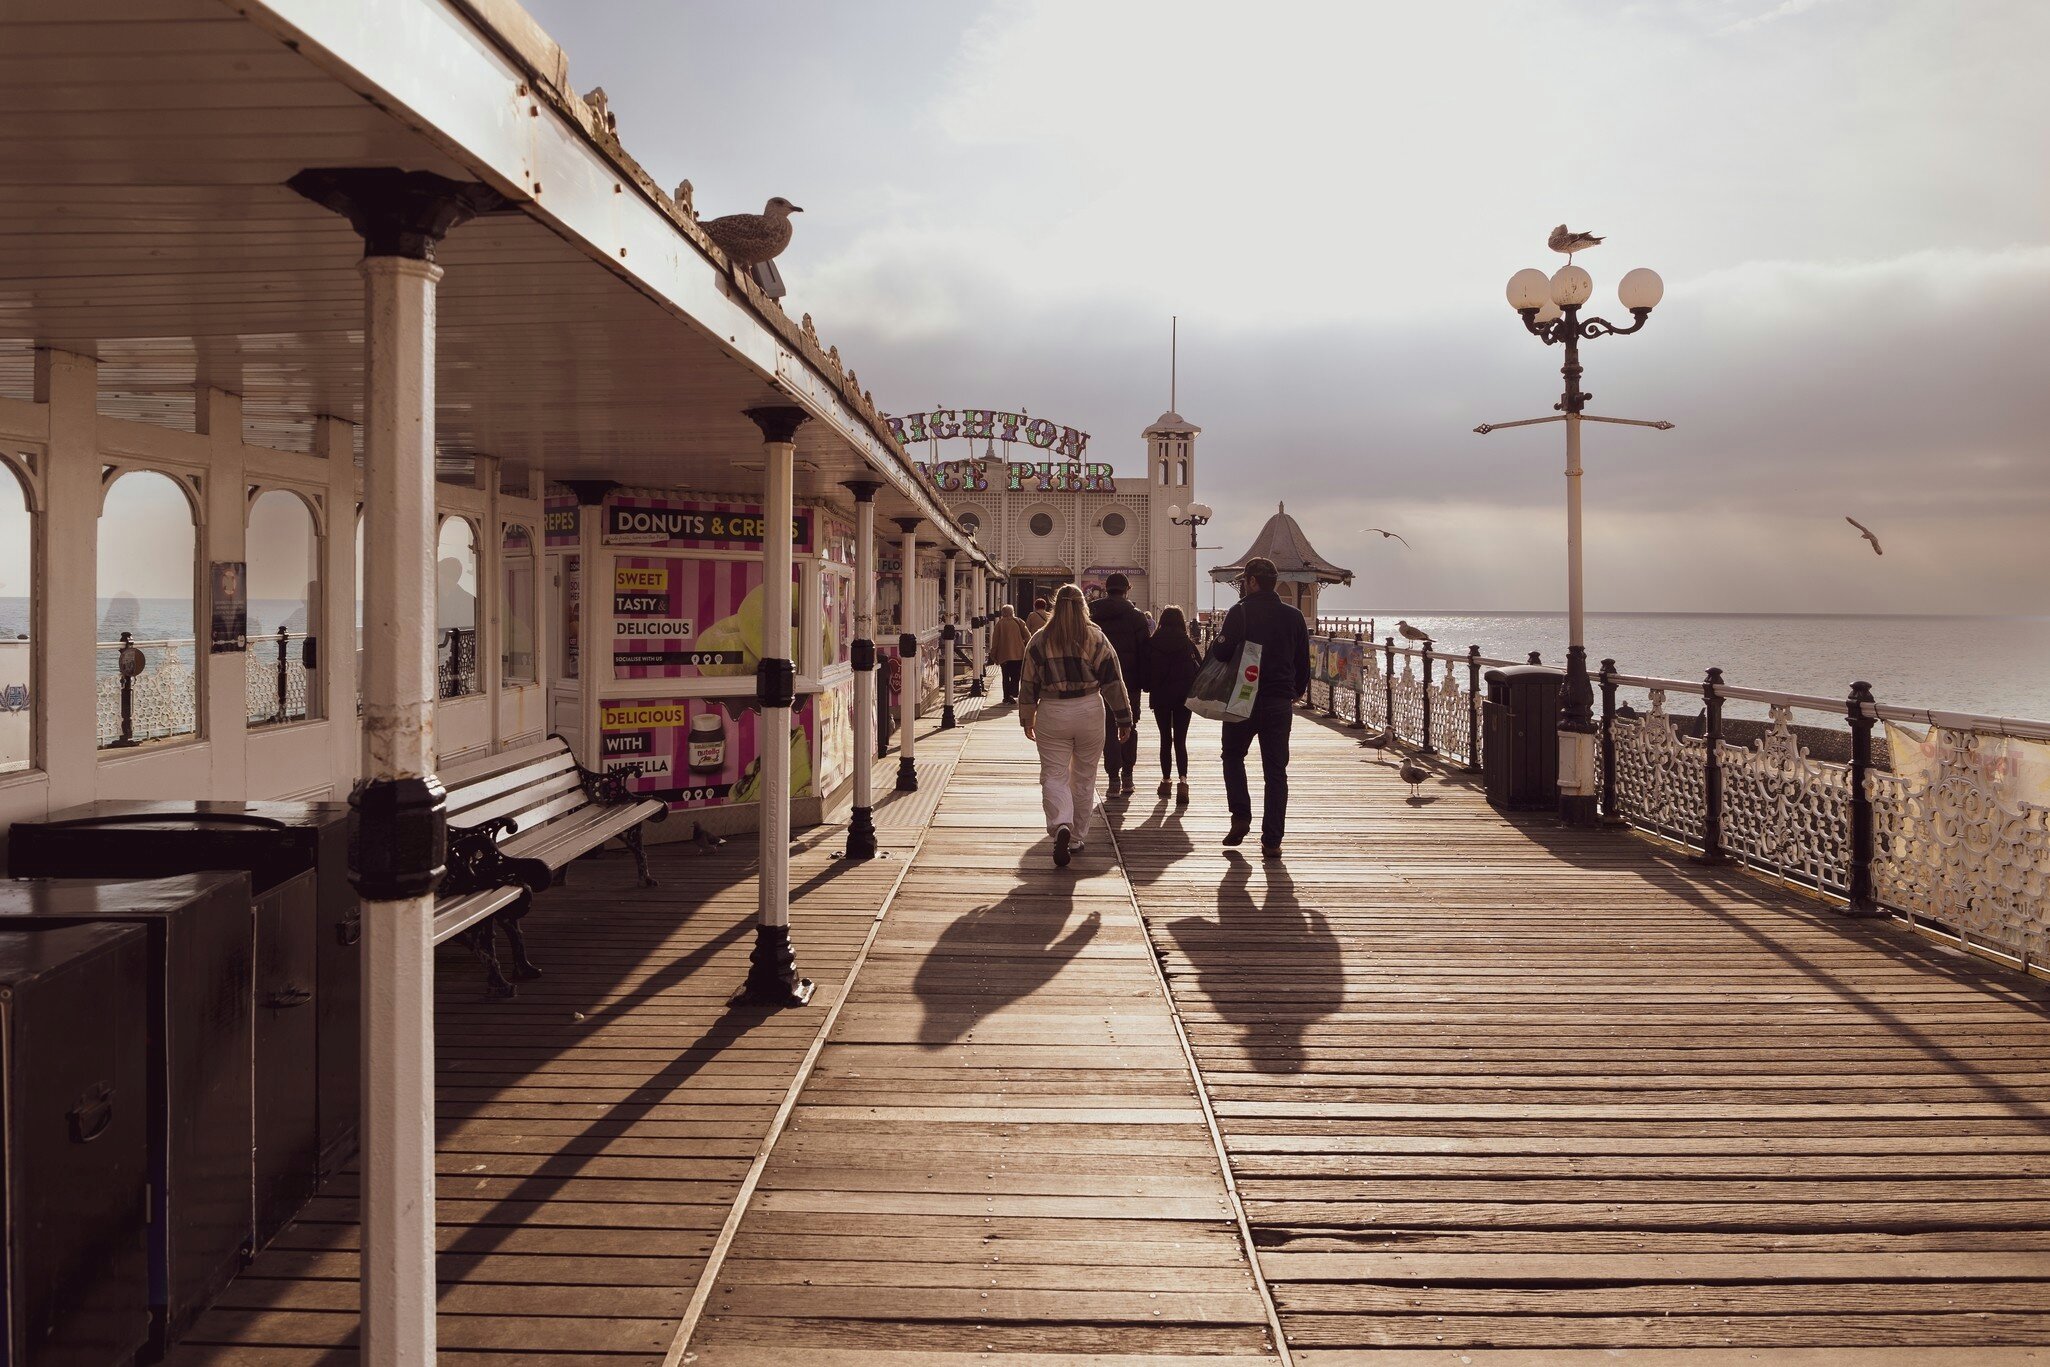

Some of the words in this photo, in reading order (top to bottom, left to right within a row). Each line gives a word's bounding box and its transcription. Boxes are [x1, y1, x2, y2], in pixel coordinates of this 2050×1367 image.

[885, 410, 1091, 460] RIGHTON
[1007, 462, 1117, 493] PIER
[544, 512, 574, 530] REPES
[618, 512, 705, 534] DONUTS
[711, 517, 725, 535] &
[729, 518, 799, 539] CRES
[882, 560, 902, 570] FLO
[617, 573, 662, 585] SWEET
[617, 599, 657, 610] TASTY
[658, 601, 666, 610] &
[617, 623, 689, 634] DELICIOUS
[606, 710, 682, 725] DELICIOUS
[607, 737, 642, 751] WITH
